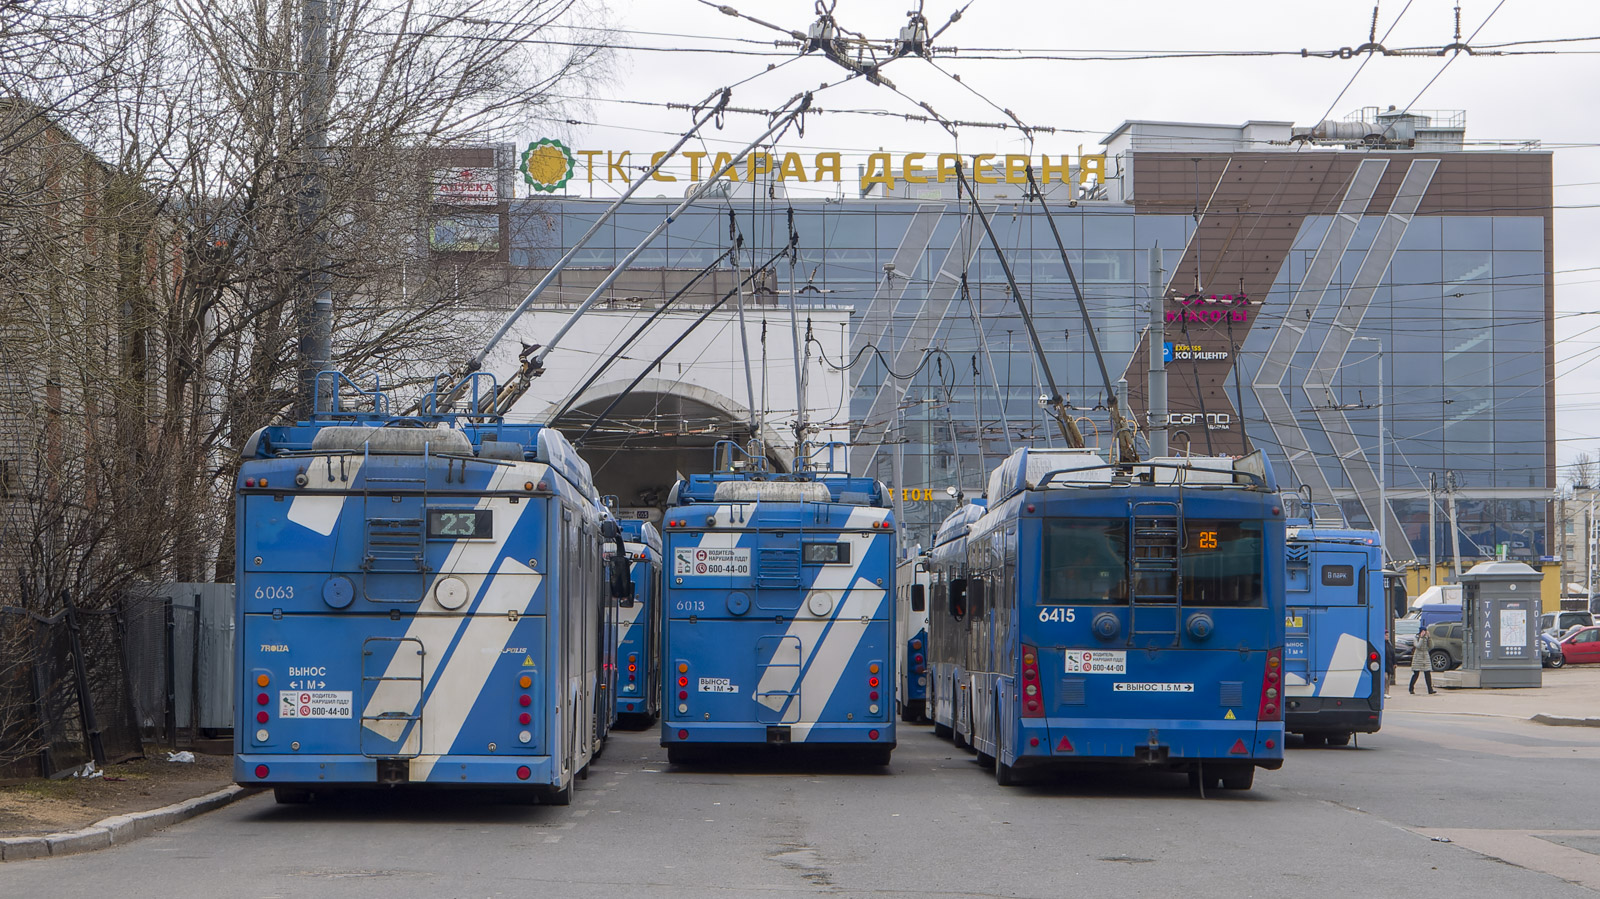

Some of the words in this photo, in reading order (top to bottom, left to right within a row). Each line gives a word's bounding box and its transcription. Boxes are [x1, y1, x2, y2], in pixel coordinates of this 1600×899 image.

[577, 150, 630, 183] ТК
[651, 151, 840, 182] СТАРАЯ
[861, 151, 1105, 190] ДЕРЕВНЯ
[440, 183, 495, 192] АПТЕКА
[1167, 310, 1247, 322] КРАСОТЫ
[440, 512, 476, 536] 23
[1199, 531, 1218, 549] 25
[708, 564, 748, 573] 600-44-00
[254, 586, 294, 600] 6063
[676, 600, 705, 611] 6013
[1038, 607, 1076, 623] 6415
[288, 666, 326, 676] ВЫНОС
[300, 680, 303, 689] 1
[311, 707, 350, 716] 600-44-00
